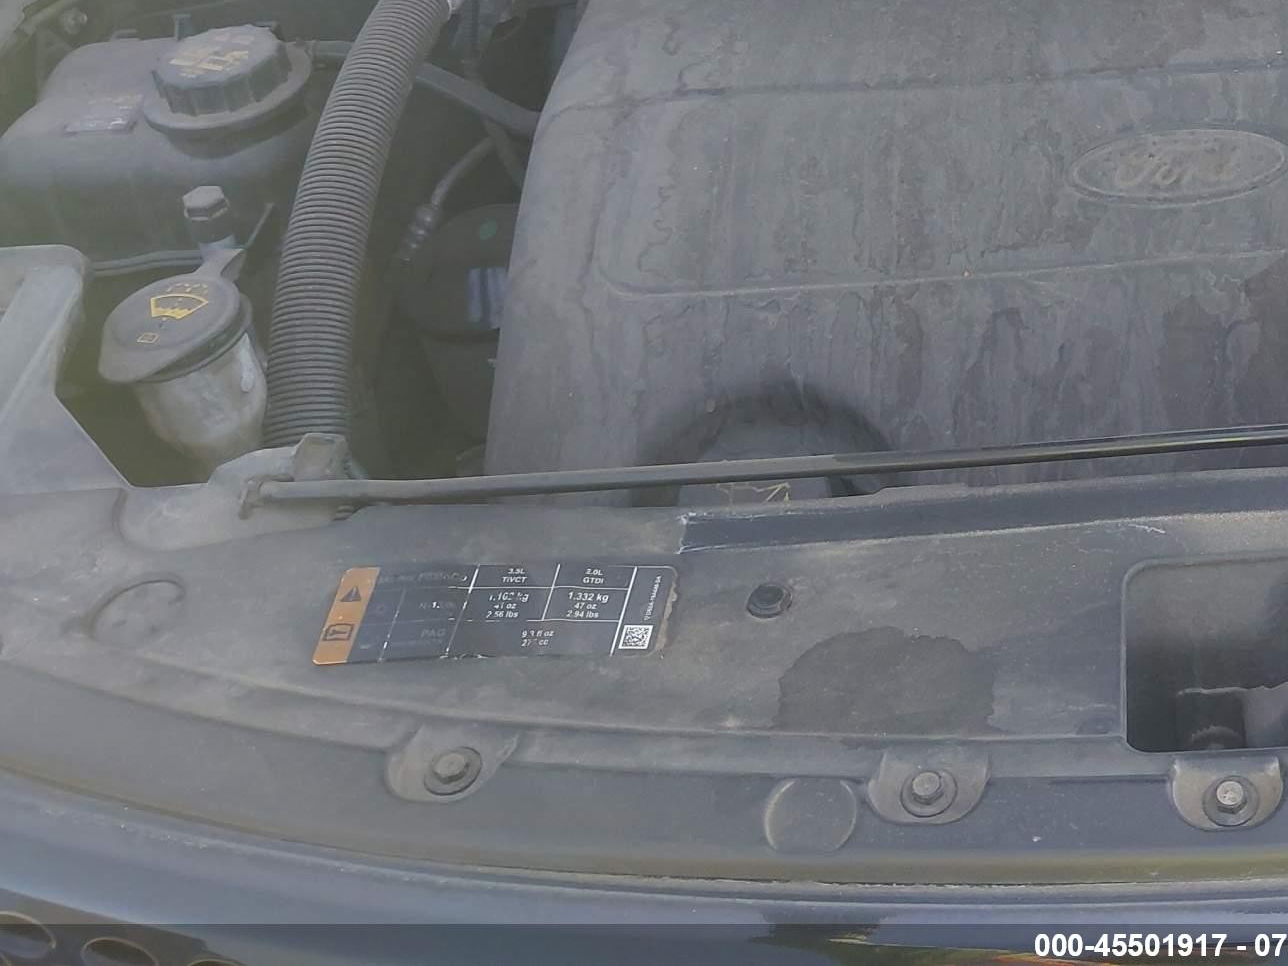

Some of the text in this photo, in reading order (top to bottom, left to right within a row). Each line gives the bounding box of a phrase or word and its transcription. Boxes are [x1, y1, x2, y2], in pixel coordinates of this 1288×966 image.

[568, 591, 609, 604] 1.332 kg
[505, 610, 519, 618] lbs
[585, 610, 599, 618] lbs
